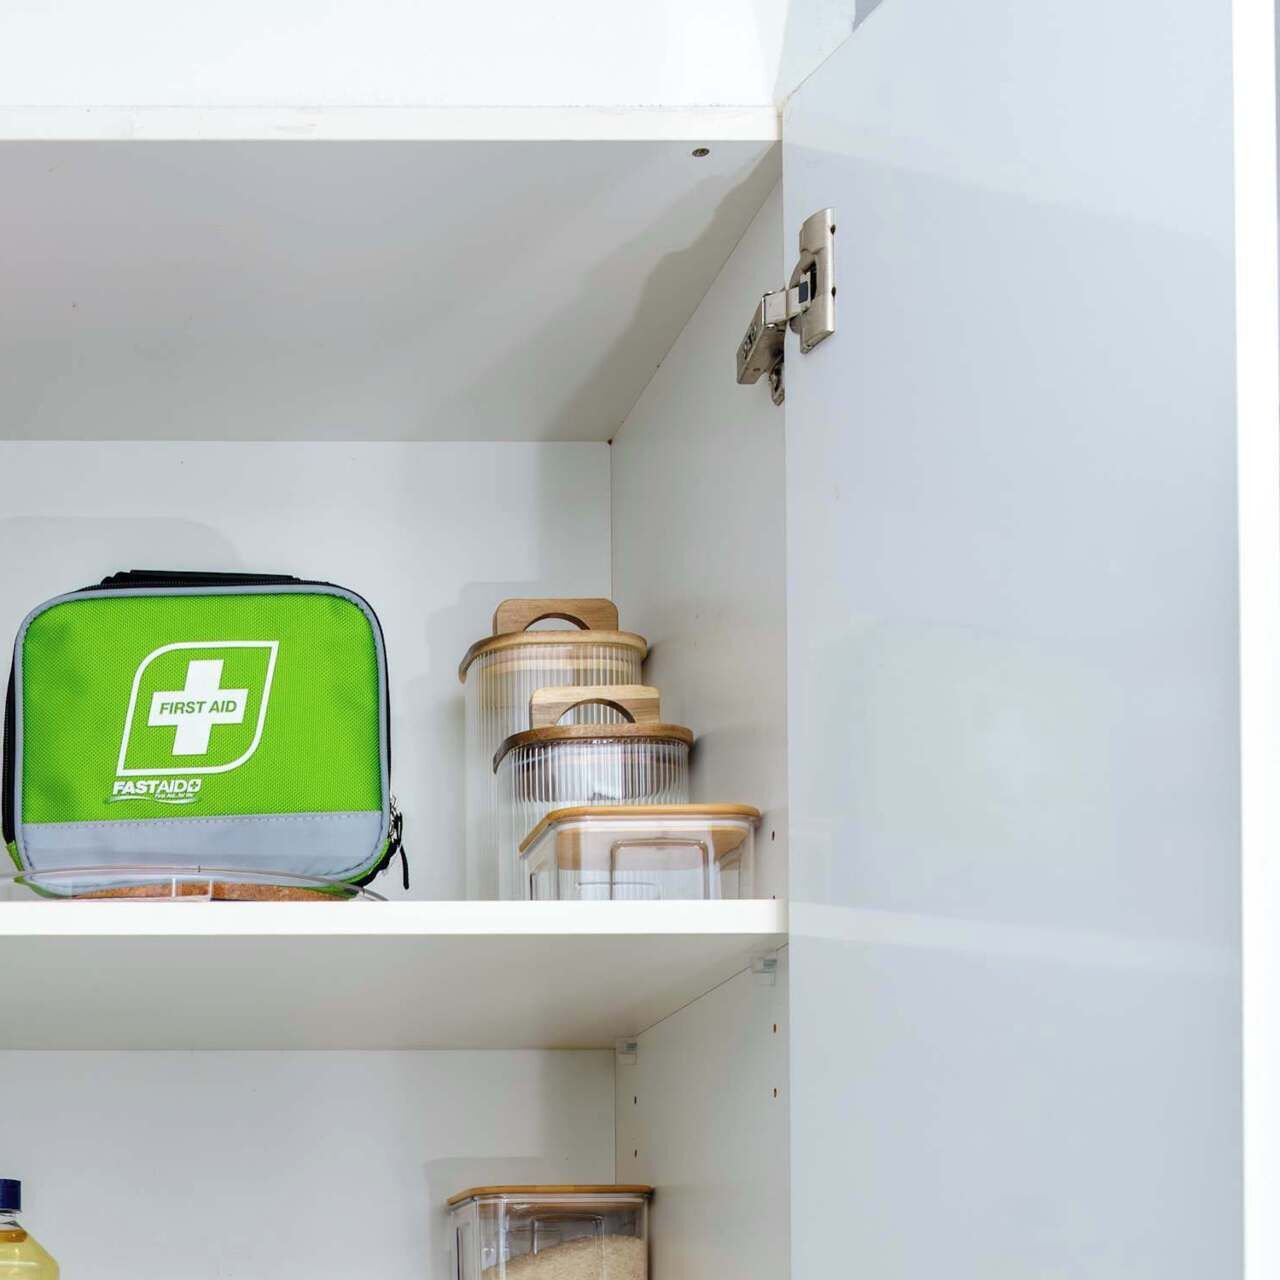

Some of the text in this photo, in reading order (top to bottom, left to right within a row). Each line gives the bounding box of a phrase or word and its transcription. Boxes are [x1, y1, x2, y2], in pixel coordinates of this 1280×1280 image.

[159, 699, 238, 716] FIRST AID
[112, 780, 188, 795] FASTAID
